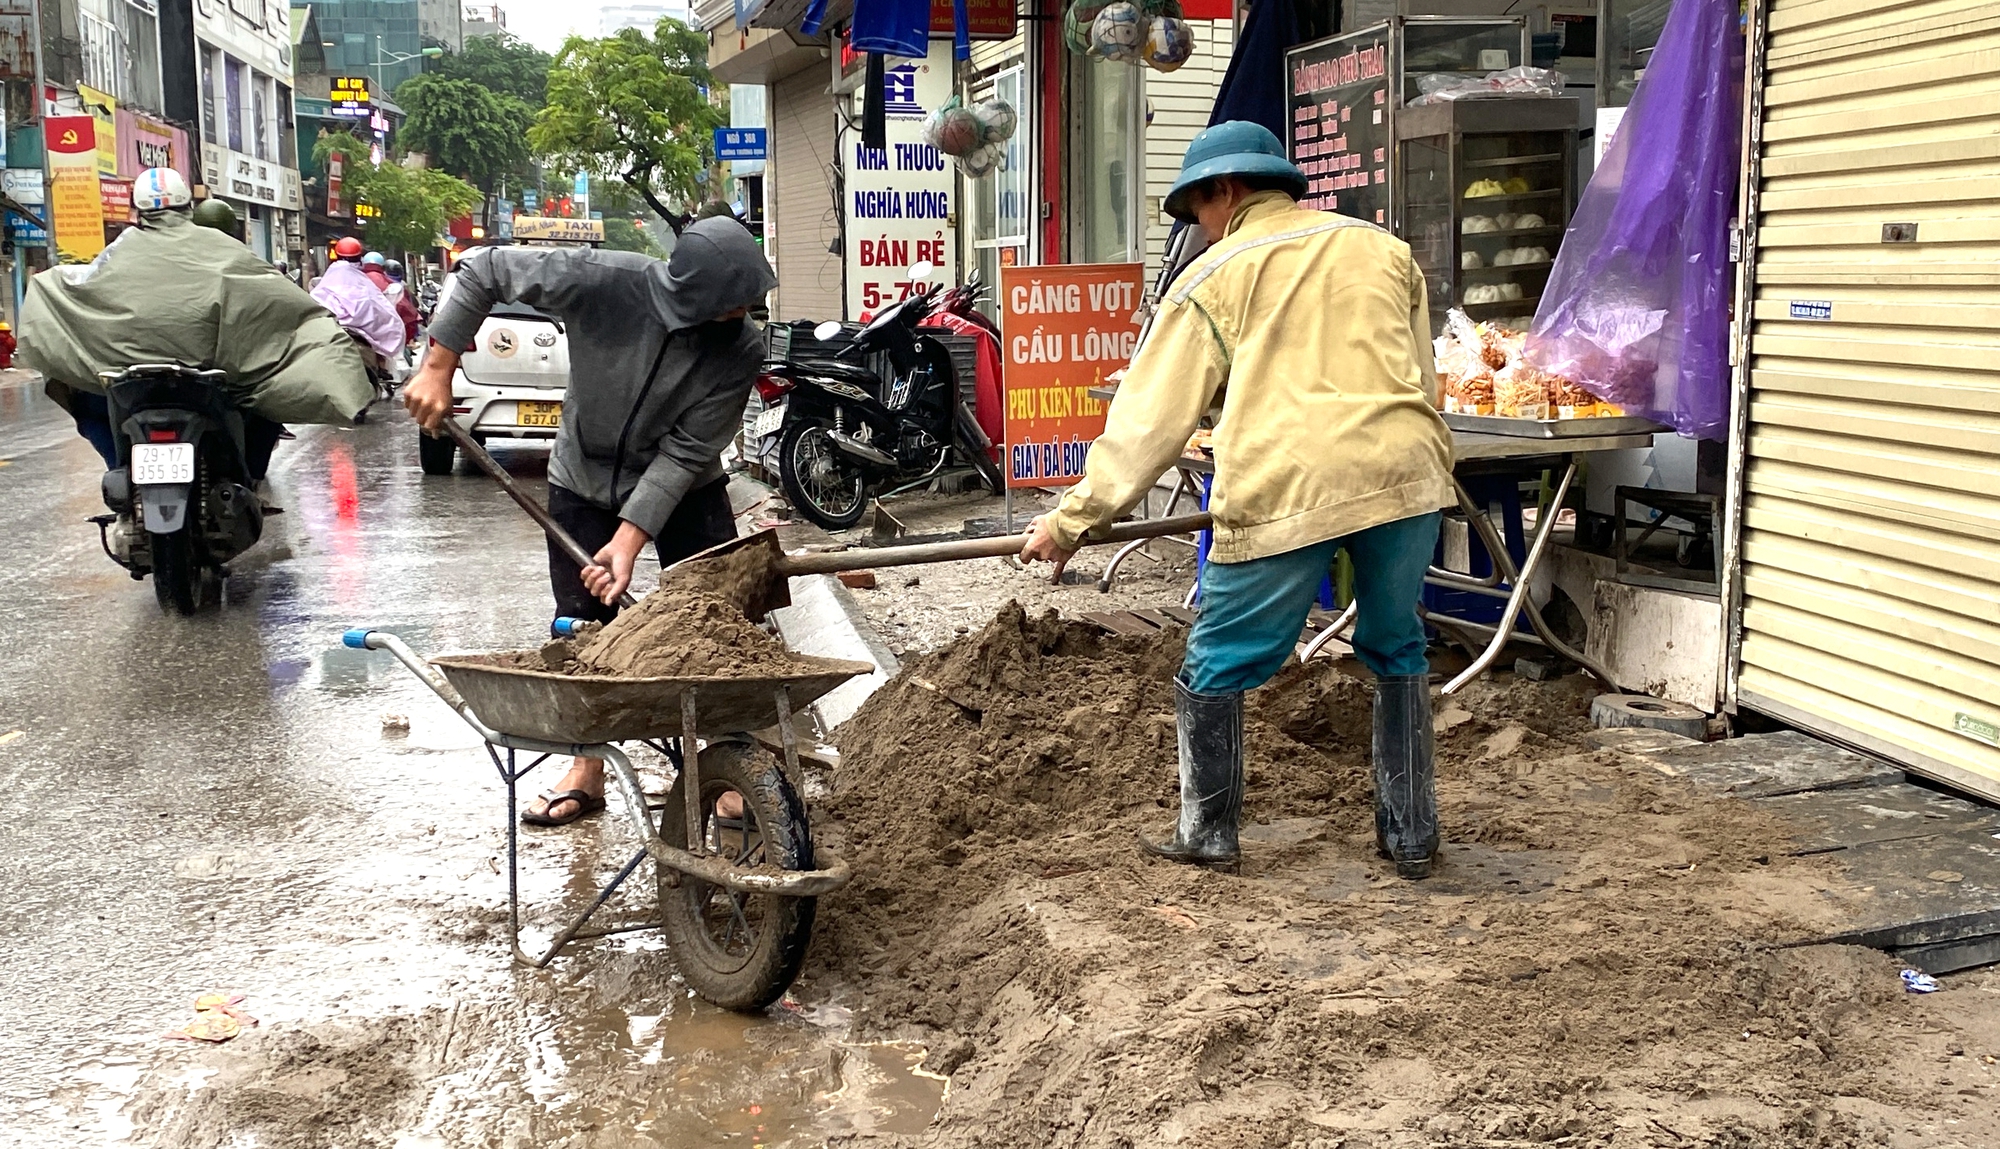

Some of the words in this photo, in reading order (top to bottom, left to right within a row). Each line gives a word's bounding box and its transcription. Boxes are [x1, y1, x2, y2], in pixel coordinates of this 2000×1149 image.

[1320, 58, 1338, 90] BAO
[855, 187, 902, 218] NGHĨA
[906, 189, 948, 219] HƯNG
[564, 221, 593, 231] TAXI
[860, 234, 908, 266] BÁN
[917, 230, 945, 266] RẺ
[1011, 279, 1081, 315] CĂNG
[1088, 280, 1135, 317] VỢT
[1012, 325, 1062, 364] CẦU
[1071, 326, 1135, 362] LÔNG
[534, 403, 555, 413] 30F
[1008, 387, 1036, 428] PHỤ
[1039, 377, 1072, 427] KIỆN
[1075, 366, 1102, 417] THỂ
[523, 414, 562, 425] 837.0
[143, 447, 183, 462] 29-Y7
[1012, 436, 1040, 480] GIÀY
[1043, 434, 1061, 478] ĐÁ
[1063, 433, 1094, 477] BÓN
